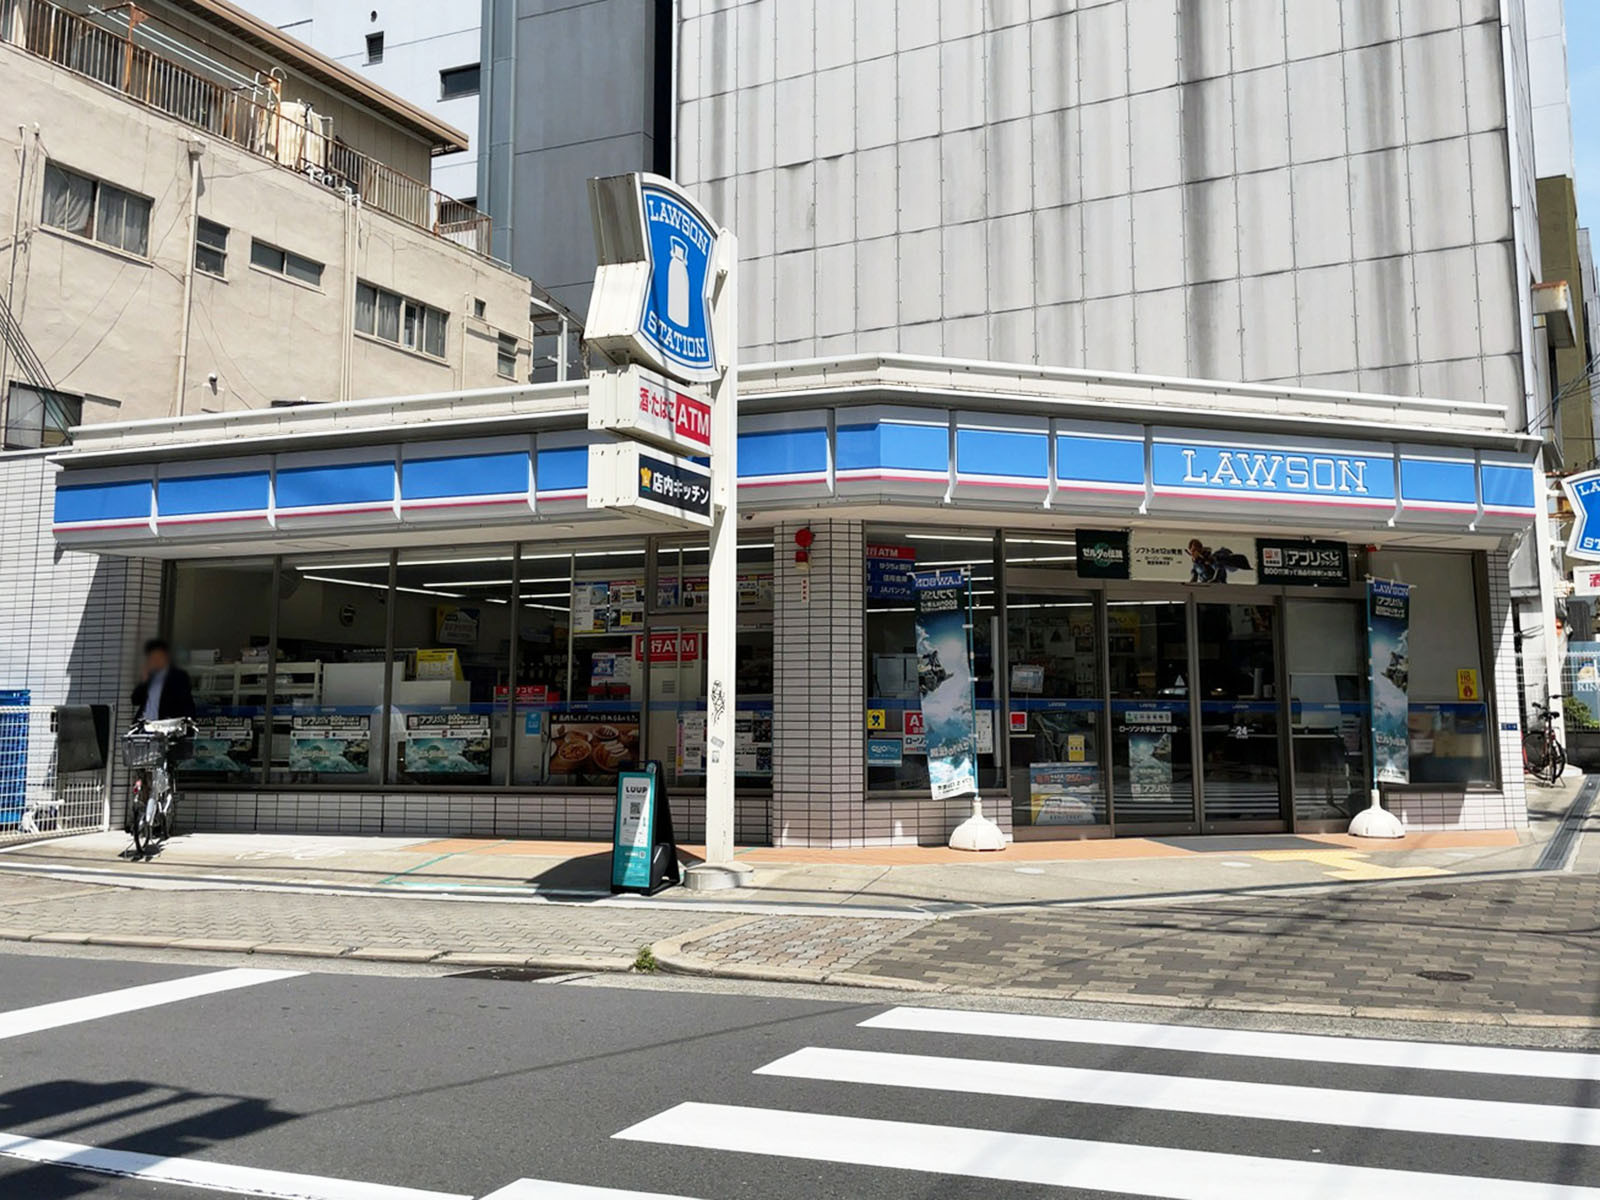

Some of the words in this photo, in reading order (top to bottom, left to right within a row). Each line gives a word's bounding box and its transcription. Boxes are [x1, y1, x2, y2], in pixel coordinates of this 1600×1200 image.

[648, 199, 709, 256] LAWSON
[647, 310, 706, 358] STATION
[677, 403, 710, 437] ATM
[652, 471, 710, 506] 店内キッチン
[1182, 449, 1368, 494] LAWSON
[1373, 583, 1409, 596] LAWSON
[1235, 726, 1248, 735] 24
[625, 786, 648, 794] LUUP
